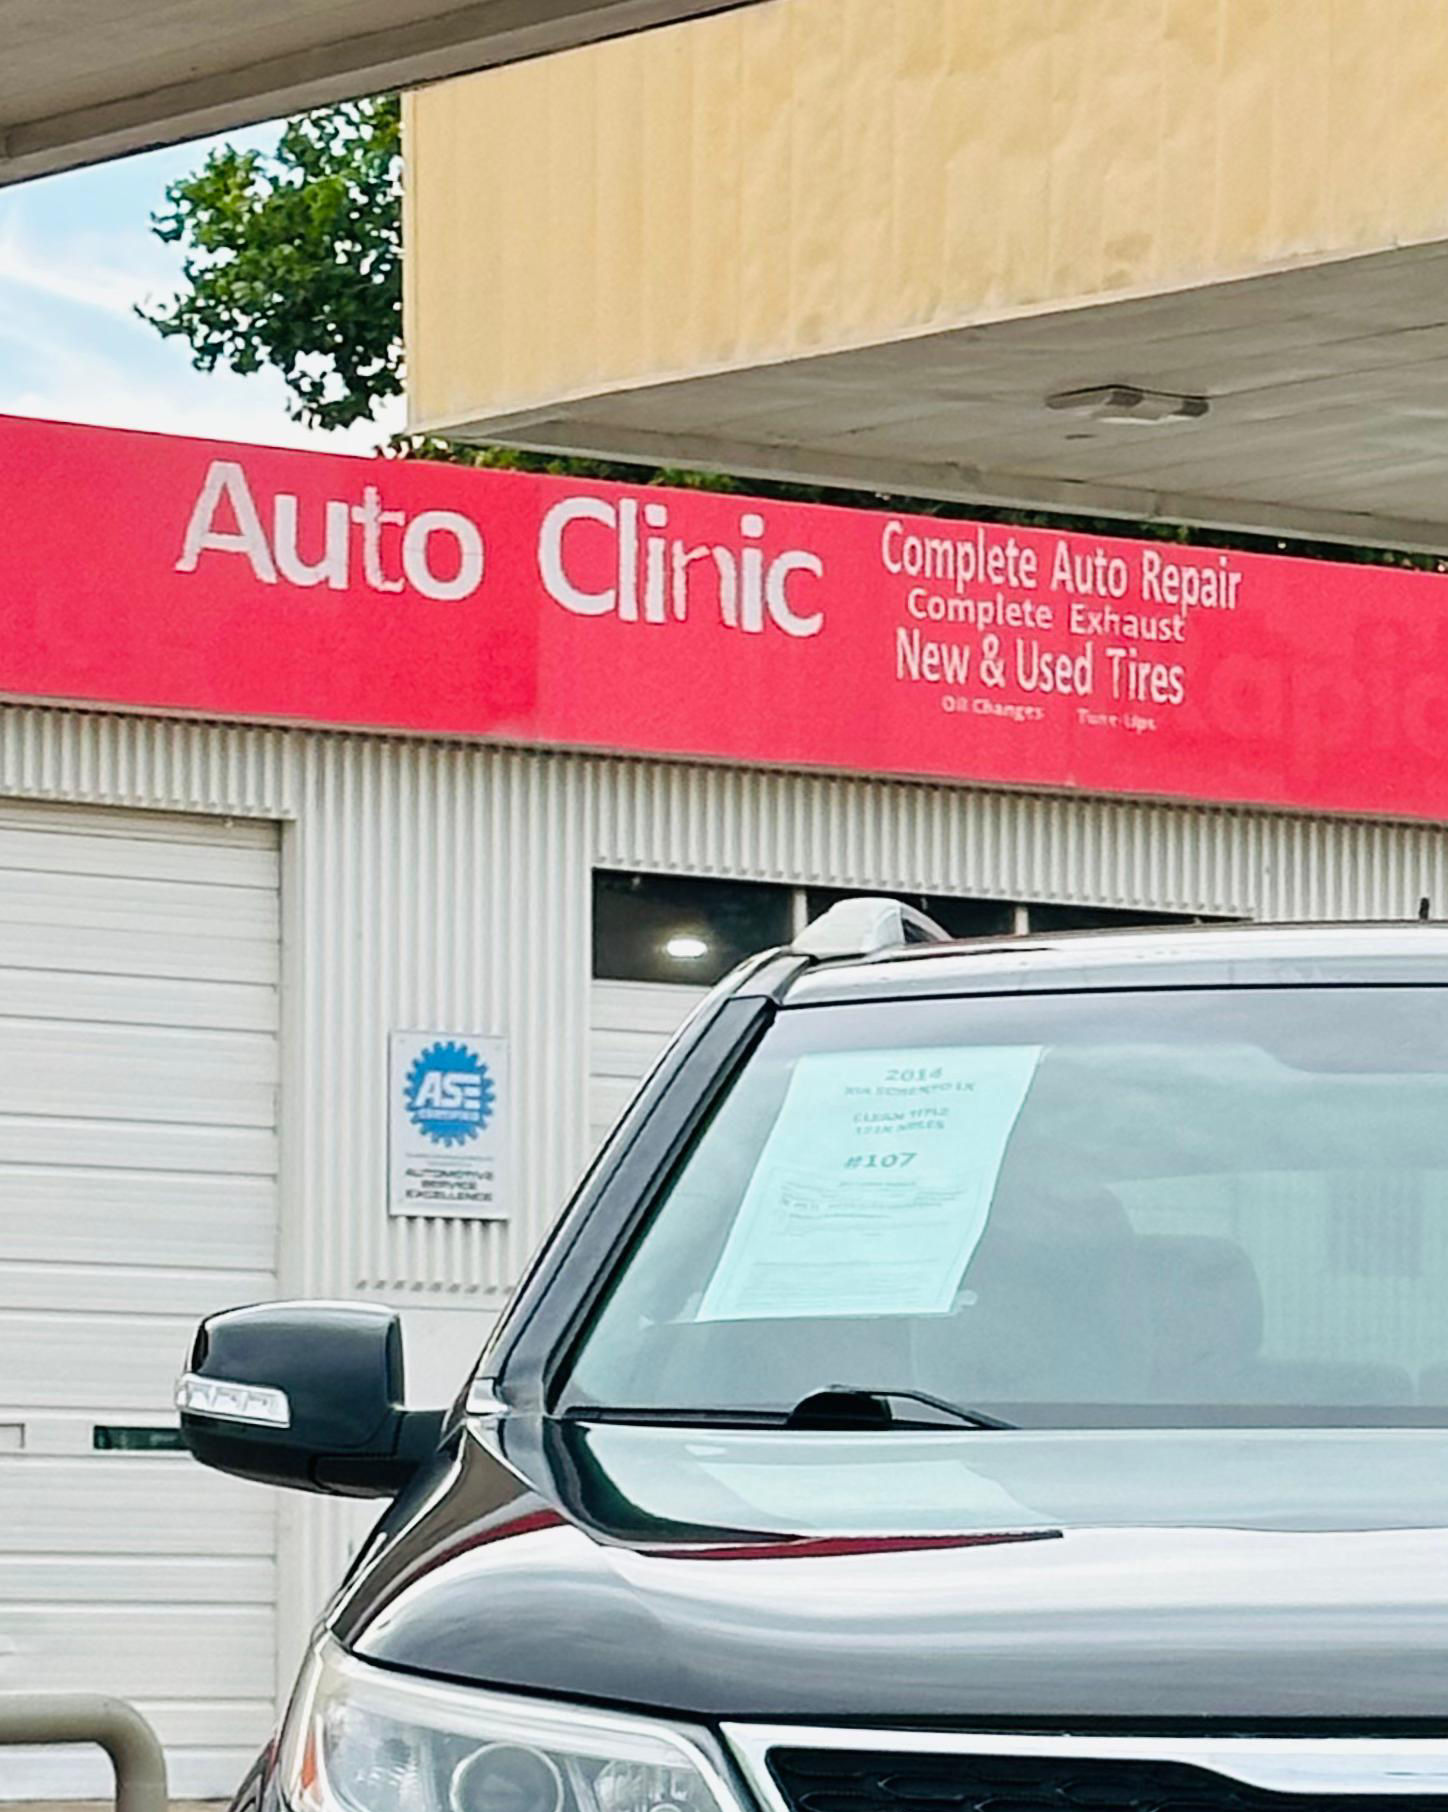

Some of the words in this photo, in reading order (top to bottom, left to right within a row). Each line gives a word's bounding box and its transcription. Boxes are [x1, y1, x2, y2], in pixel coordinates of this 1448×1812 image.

[175, 460, 484, 601] Auto
[538, 497, 824, 637] Clinic
[882, 520, 1037, 594] Complete
[1051, 539, 1128, 599] Auto
[1142, 550, 1242, 616] Repair
[907, 587, 1054, 631] Complete
[1069, 602, 1187, 643] Exhaust
[896, 627, 970, 685] New
[979, 633, 1006, 688] &
[1015, 637, 1093, 697] Used
[1105, 647, 1185, 705] Tires
[415, 1071, 481, 1109] ASE
[843, 1151, 918, 1169] #107
